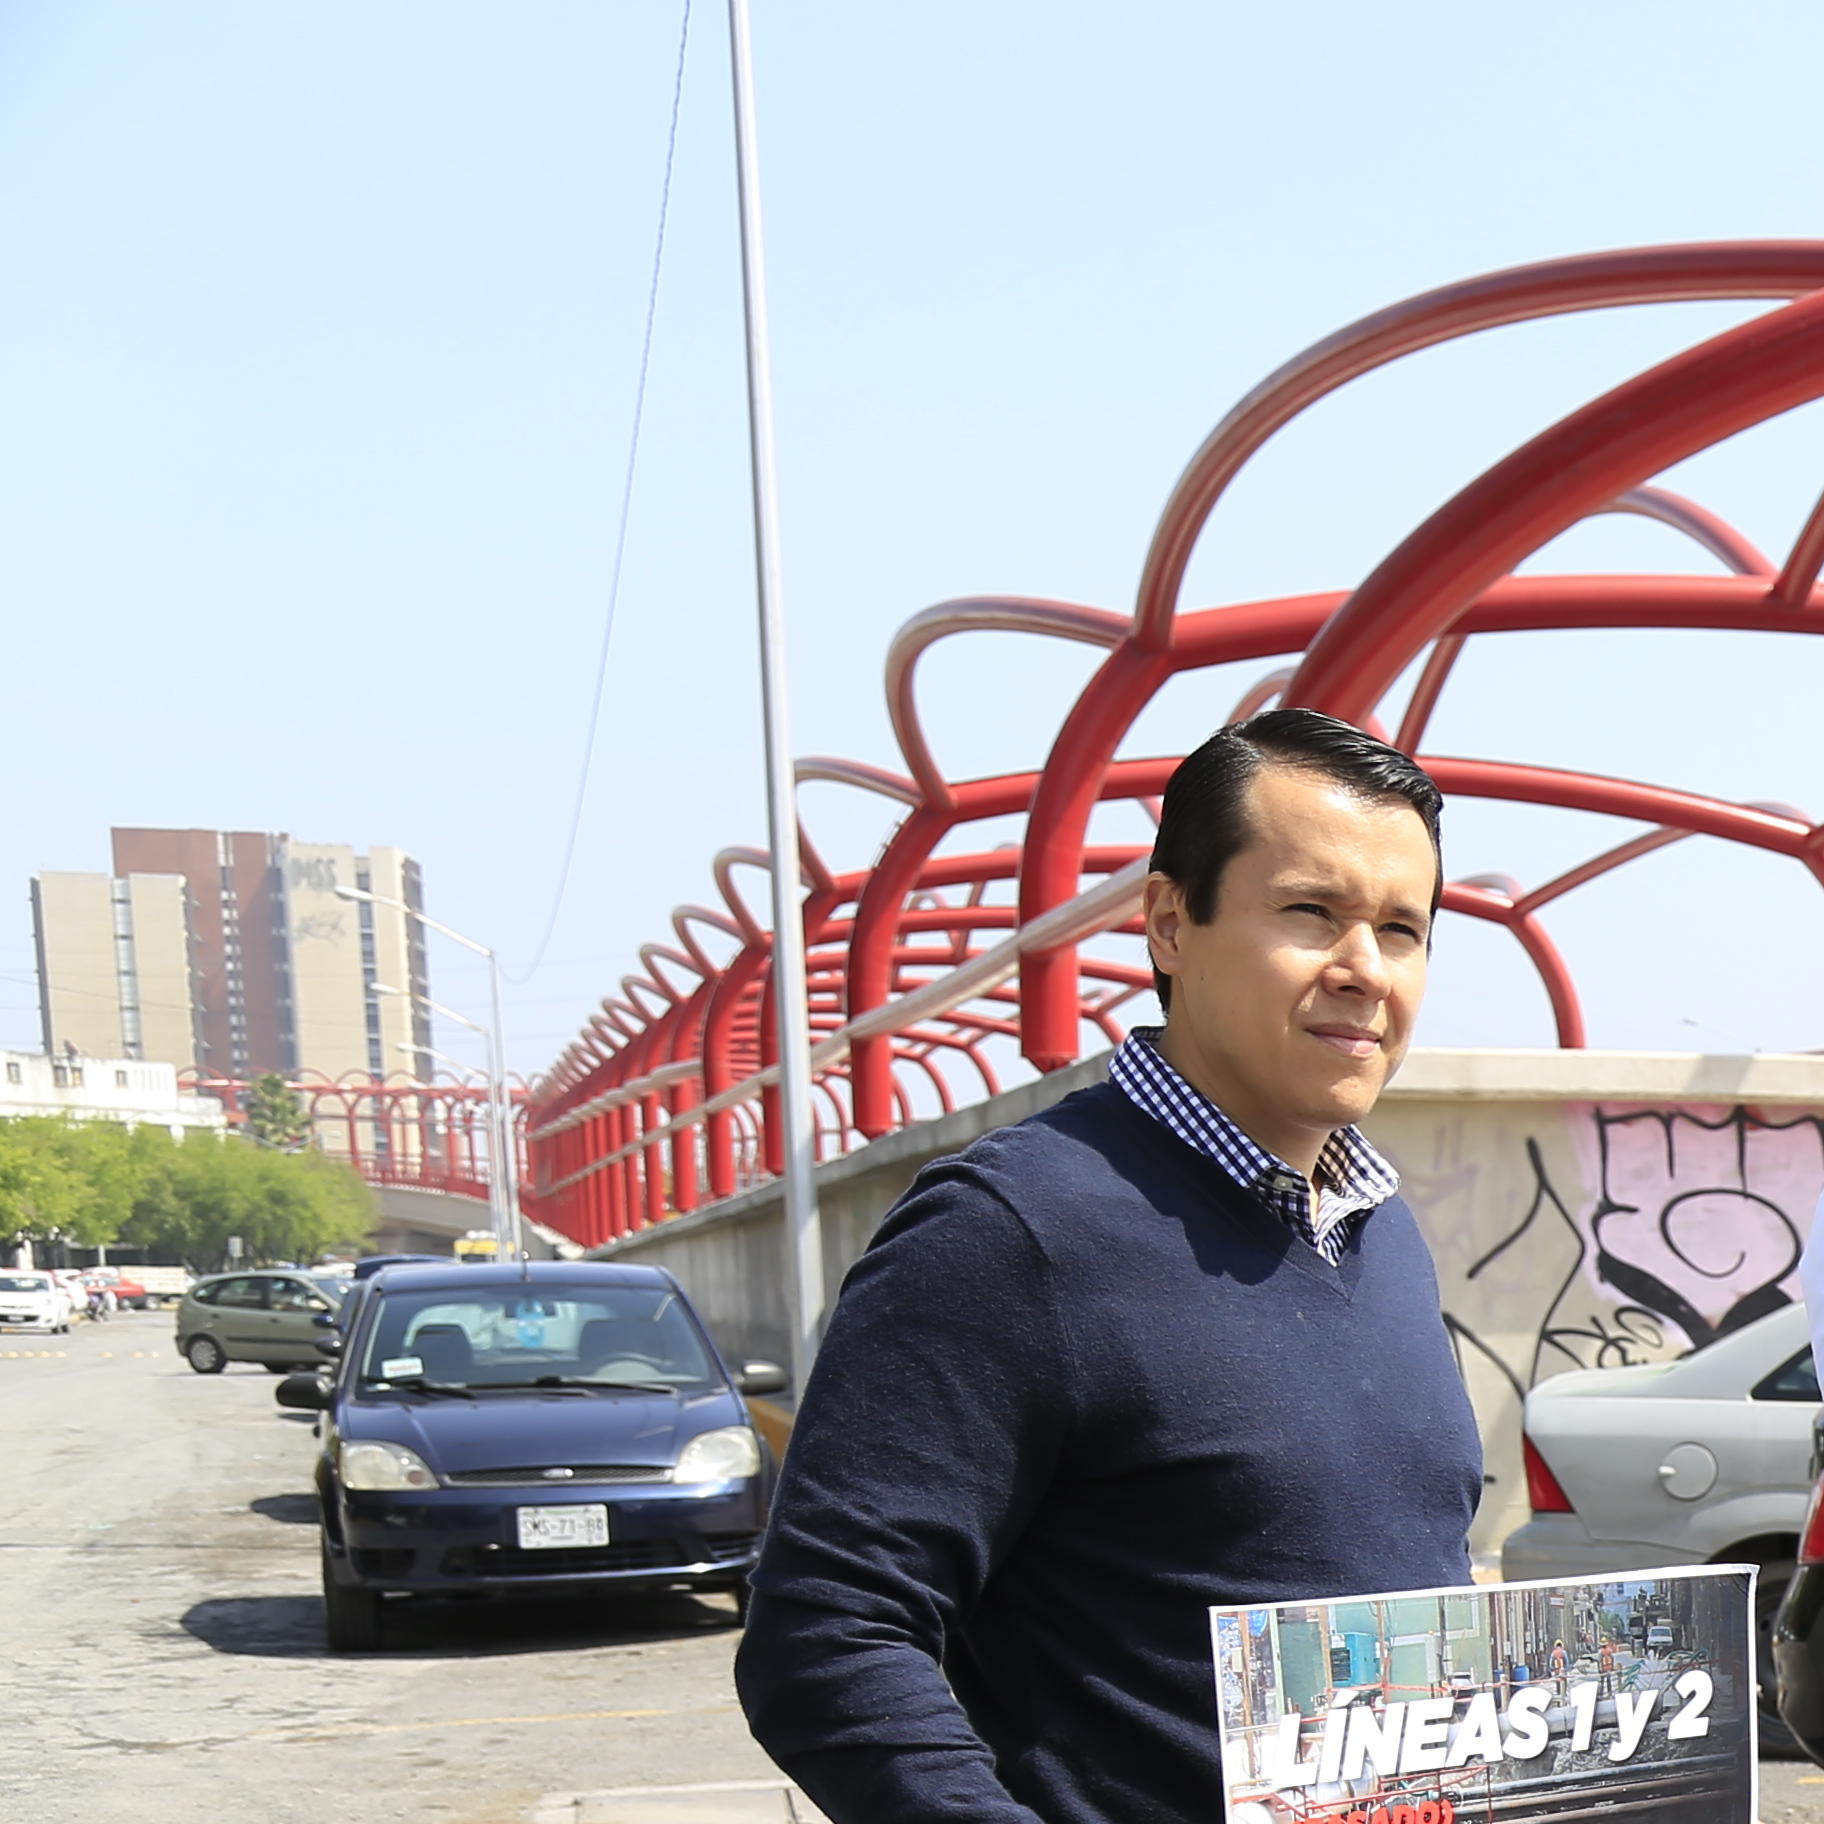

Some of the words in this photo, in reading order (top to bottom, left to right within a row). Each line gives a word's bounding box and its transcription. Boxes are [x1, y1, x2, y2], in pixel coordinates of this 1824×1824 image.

[1270, 1687, 1552, 1788] LÍNEAS
[1569, 1680, 1598, 1752] 1
[1608, 1689, 1657, 1761] y
[1666, 1669, 1715, 1741] 2
